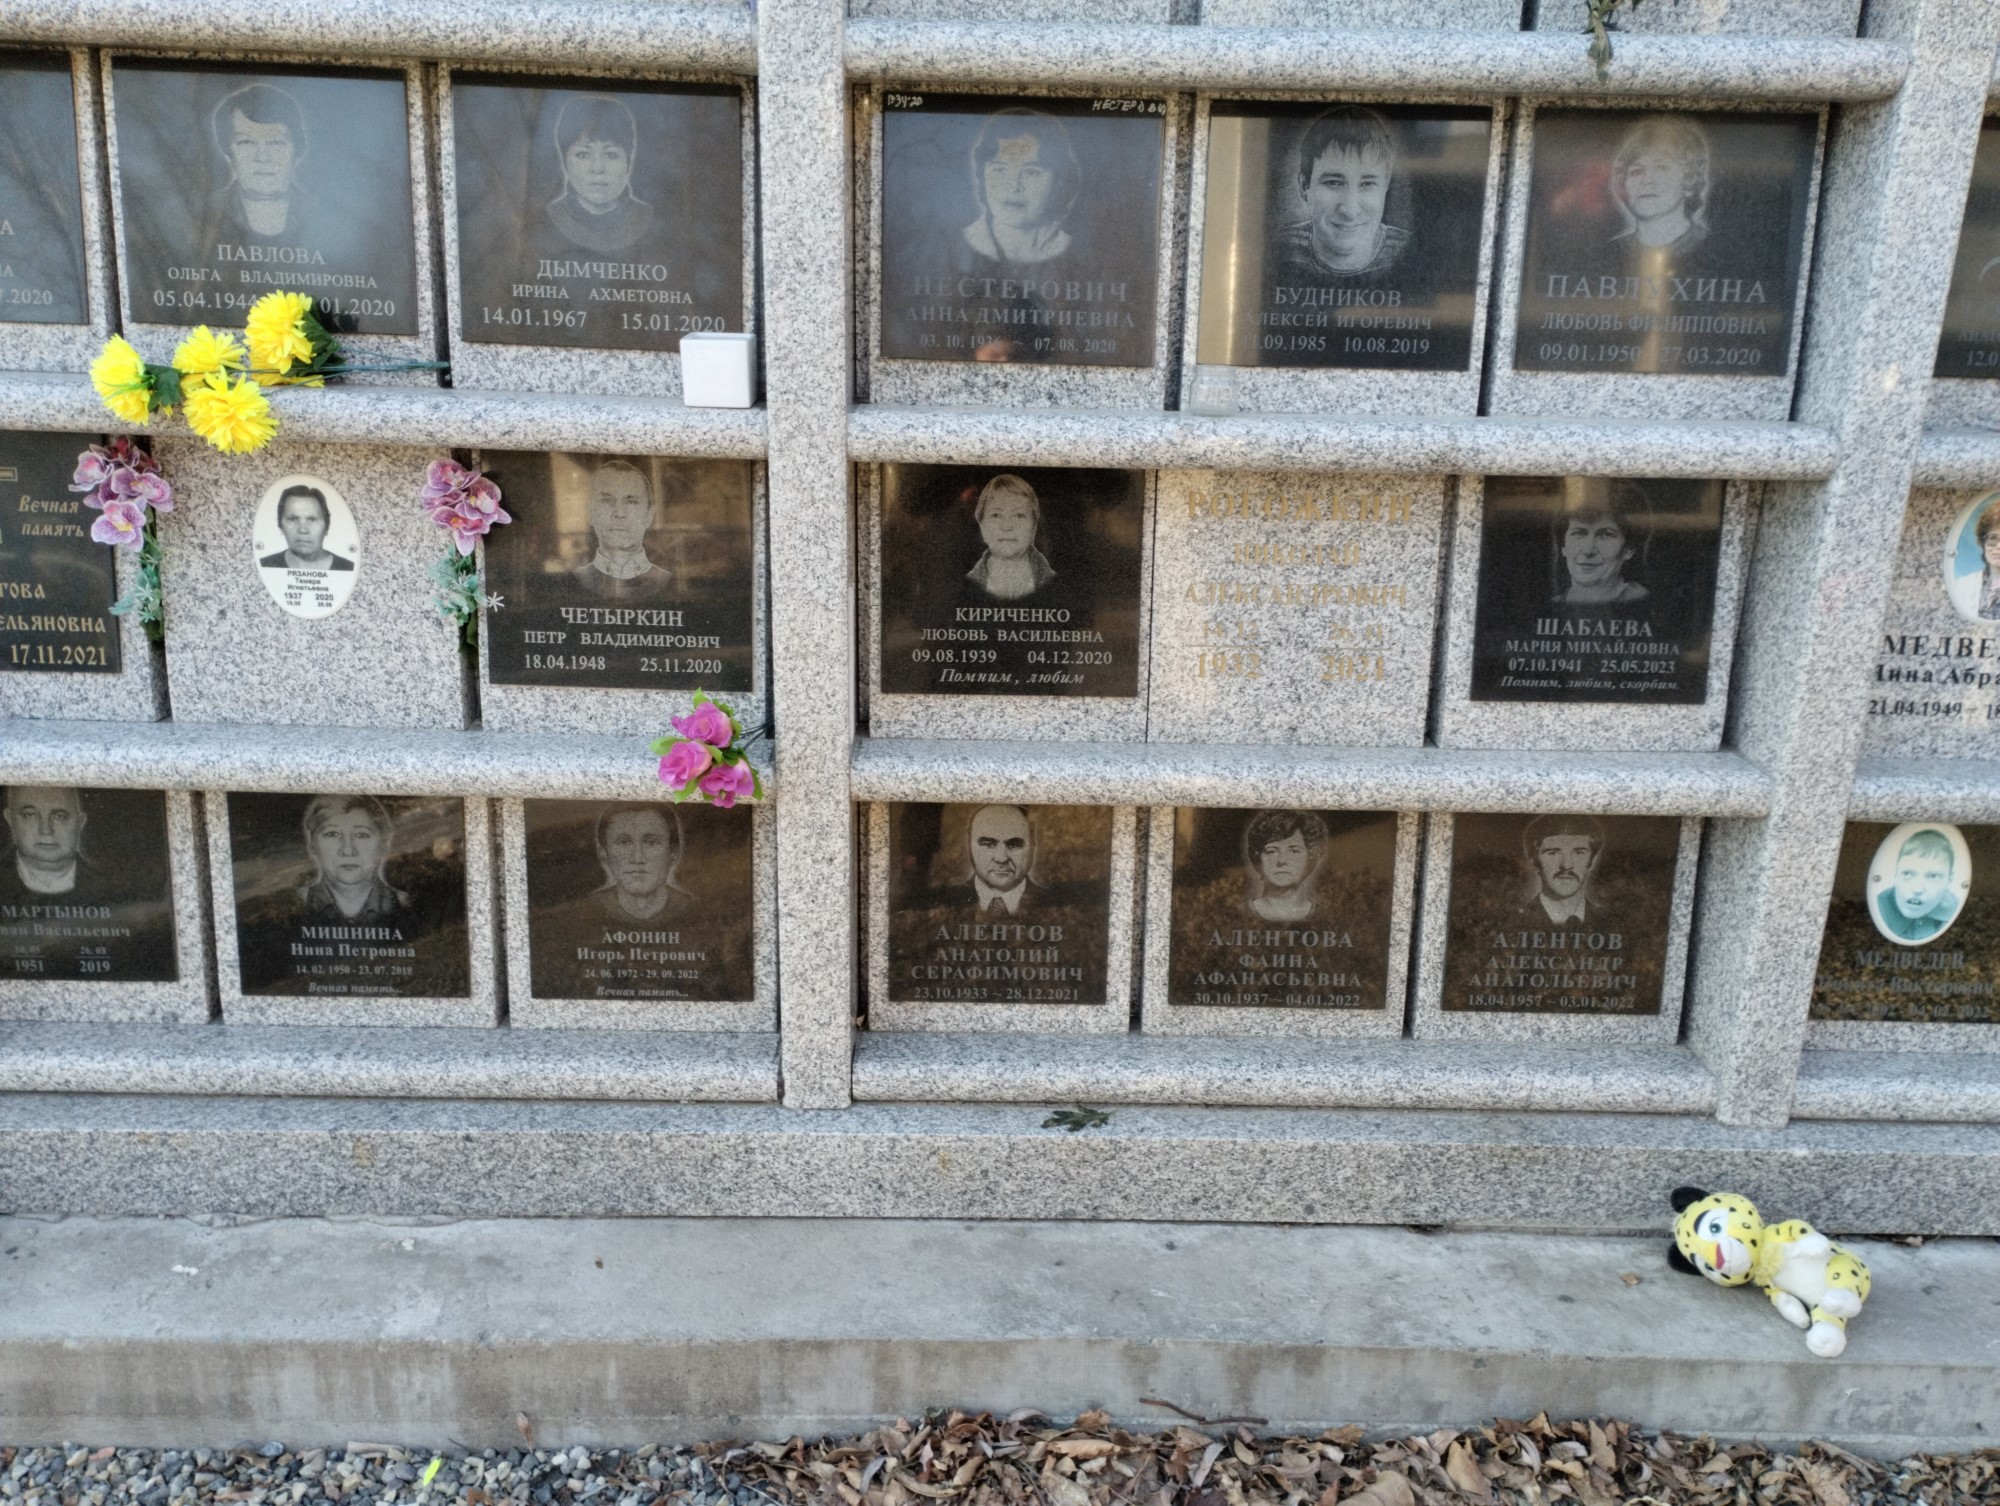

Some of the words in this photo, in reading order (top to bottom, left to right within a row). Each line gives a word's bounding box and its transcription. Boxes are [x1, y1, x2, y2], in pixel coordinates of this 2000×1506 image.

[217, 244, 326, 265] ПАВЛОВА
[168, 266, 221, 282] ОЛЬГА
[240, 271, 377, 289] ВЛАДИМИРОВНА
[537, 260, 667, 282] ДЫМЧЕНКО
[512, 284, 569, 299] ИРИНА
[588, 288, 693, 304] АХМЕТОВНА
[913, 276, 1128, 302] НЕСТЕРОВИЧ
[1275, 287, 1401, 308] БУДНИКОВ
[154, 289, 257, 310] 05.04.1944
[319, 298, 396, 318] 01.2020
[482, 307, 587, 328] 14.01.1967
[621, 313, 726, 333] 15.01.2020
[905, 306, 968, 323] АННА
[975, 307, 1135, 328] ДМИТРИЕВНА
[1337, 314, 1432, 330] ИГОРЕВИЧ
[1540, 312, 1623, 331] ЛЮБОВЬ
[1344, 337, 1430, 354] 10.08.2019
[1540, 343, 1641, 363] 09.01.1950
[1661, 346, 1762, 366] 27.03.2020
[18, 495, 79, 513] Вечная
[1187, 489, 1412, 523] РОГОЖКИН
[22, 523, 84, 537] память
[287, 570, 328, 578] РЯЗАНОВА
[560, 607, 684, 627] ЧЕТЫРКИН
[955, 607, 1071, 623] КИРИЧЕНКО
[920, 628, 988, 642] ЛЮБОВЬ
[998, 630, 1104, 644] ВАСИЛЬЕВНА
[1536, 618, 1653, 637] ШАБАЕВА
[524, 631, 567, 644] ПЕТР
[581, 632, 721, 649] ВЛАДИМИРОВИЧ
[1505, 640, 1561, 653] МАРИЯ
[1567, 639, 1680, 656] МИХАЙЛОВНА
[1880, 634, 2000, 660] МЕДВЕ
[11, 644, 108, 666] 17.11.2021
[525, 654, 606, 671] 18.04.1948
[640, 657, 722, 674] 25.11.2020
[912, 649, 997, 664] 09.08.1939
[1027, 651, 1113, 666] 04.12.2020
[1321, 655, 1384, 682] 2021
[1508, 658, 1582, 672] 07.10.1941
[1600, 659, 1676, 674] 25.05.2023
[1026, 670, 1085, 685] любим
[1868, 698, 1963, 718] 21.04.1949
[2, 905, 111, 919] МАРТЫНОВ
[301, 926, 404, 941] МИШНИНА
[602, 931, 680, 945] АФОНИН
[936, 924, 1064, 942] АЛЕНТОВ
[1208, 929, 1354, 948] АЛЕНТОВА
[1492, 931, 1623, 950] АЛЕНТОВ
[291, 943, 333, 957] Нина
[339, 944, 416, 960] Петровна
[577, 947, 625, 963] Игорь
[630, 948, 706, 964] Петрович
[936, 946, 1060, 963] АНАТОЛИЙ
[79, 960, 111, 974] 2019
[1238, 954, 1319, 969] ФАИНА
[1486, 955, 1624, 973] АЛЕКСАНДР
[911, 965, 1083, 982] СЕРАФИМОВИЧ
[1193, 971, 1362, 988] АФАНАСЬЕВНА
[1468, 973, 1637, 990] АНАТОЛЬЕВИЧ
[914, 986, 988, 1000] 23.10.1933
[1006, 988, 1079, 1001] 28.12.2021
[1194, 992, 1269, 1005] 30.10.1937
[1468, 994, 1543, 1007] 18.04.1957
